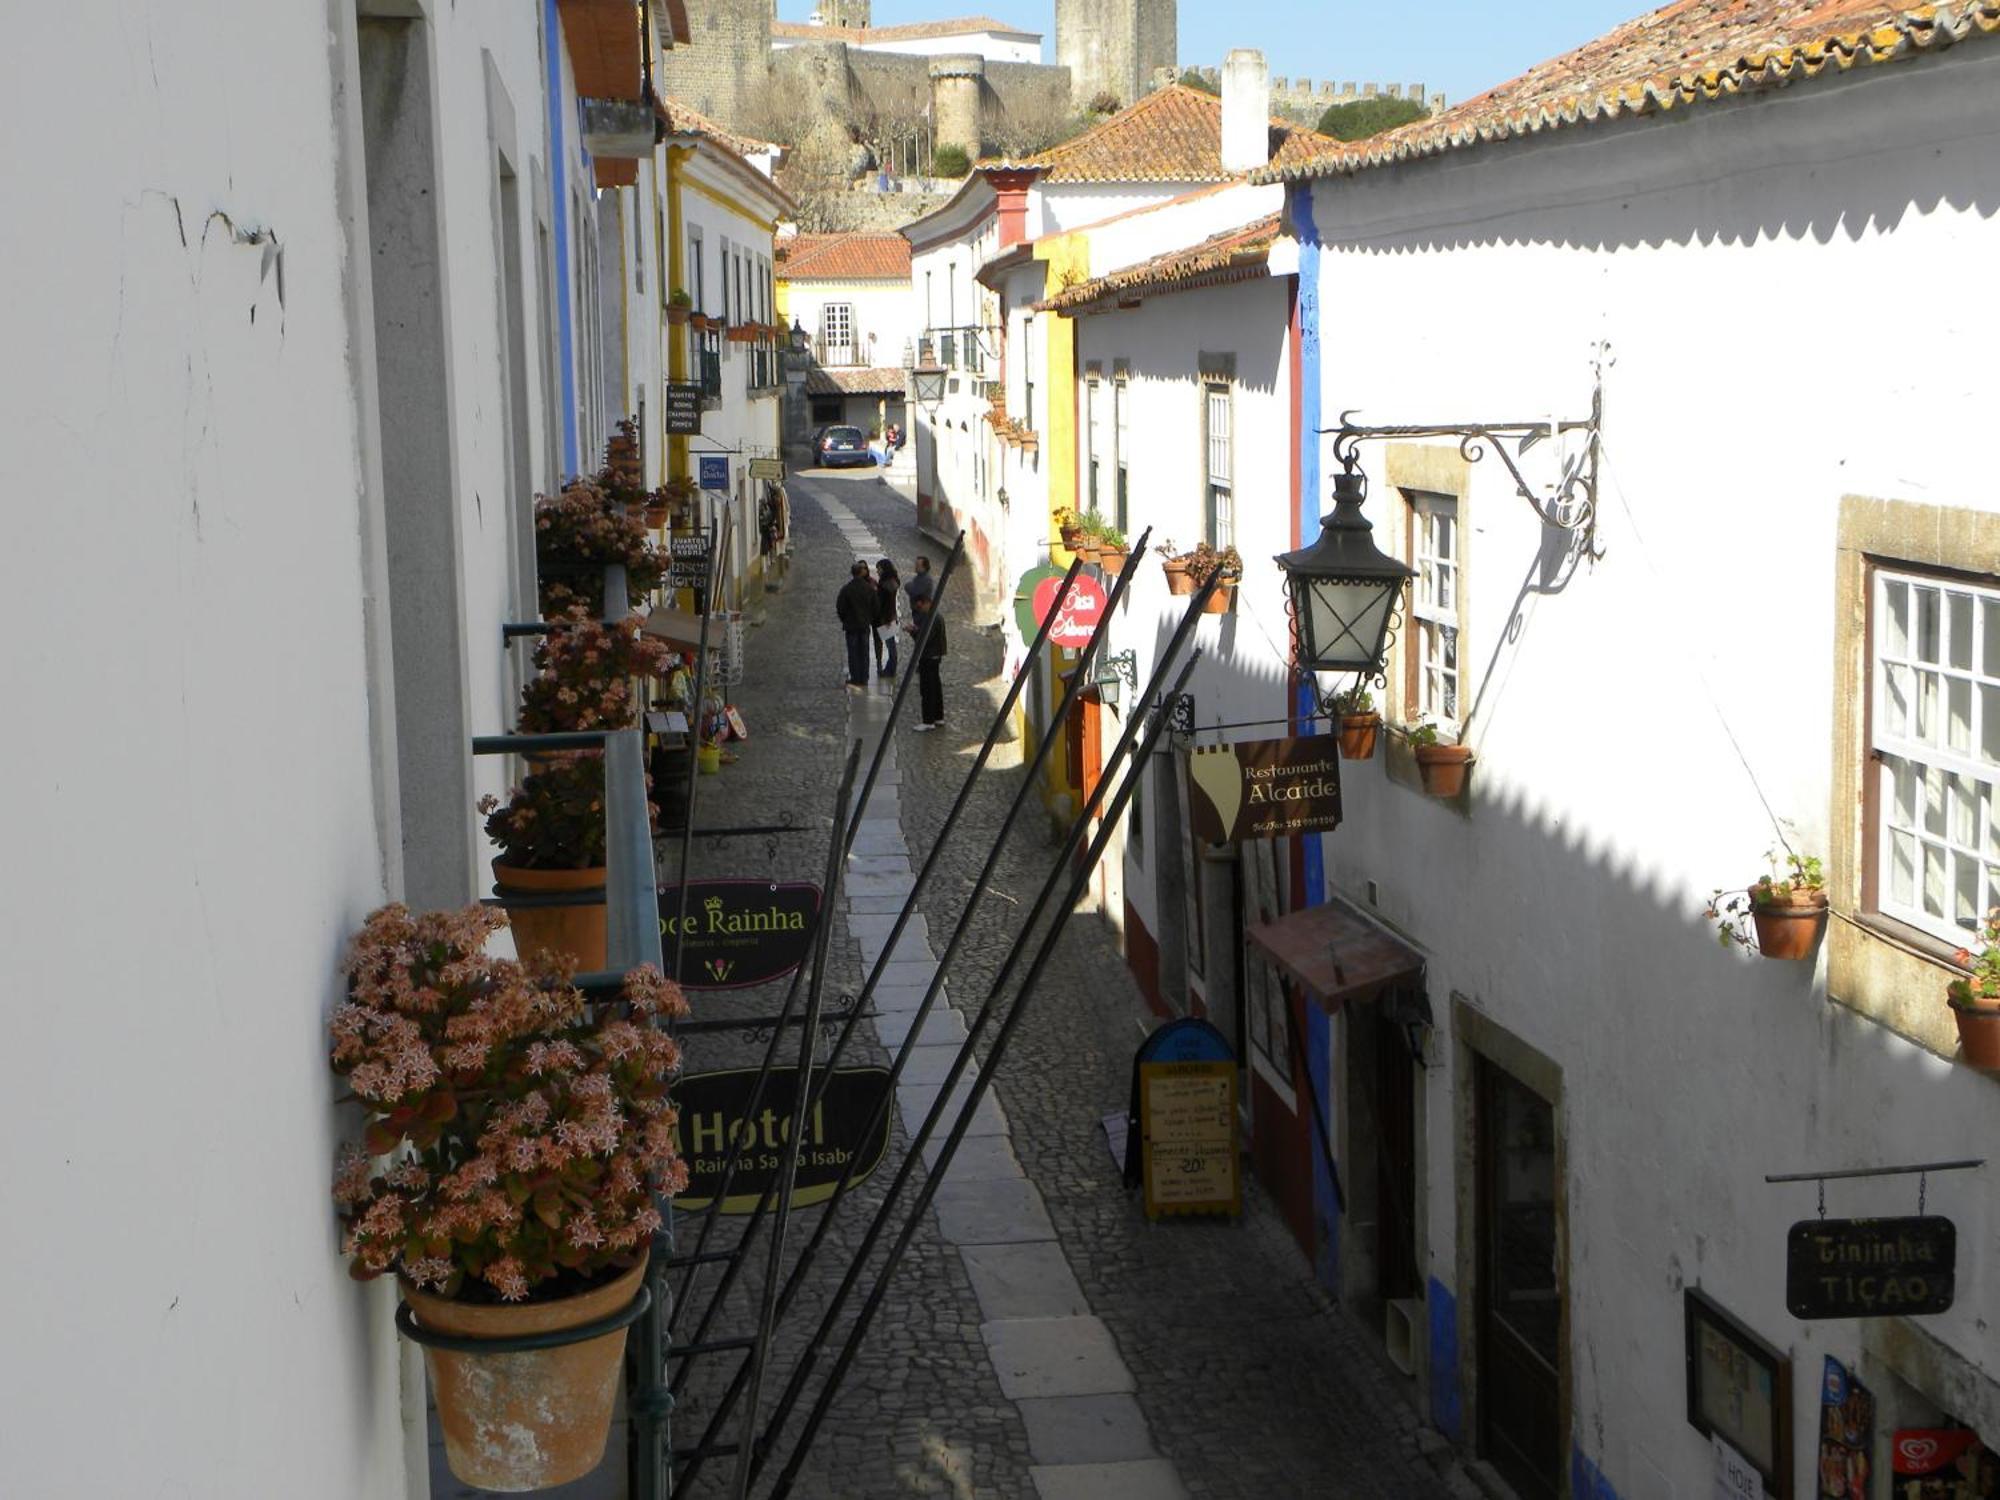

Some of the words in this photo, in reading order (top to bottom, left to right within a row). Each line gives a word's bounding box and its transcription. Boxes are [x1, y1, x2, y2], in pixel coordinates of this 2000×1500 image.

[1245, 759, 1334, 780] Restaurante
[1248, 778, 1337, 804] Alcaide
[658, 915, 697, 936] oce
[707, 906, 805, 936] Rainha
[759, 1153, 806, 1170] Saa
[1728, 1460, 1754, 1499] HOJE
